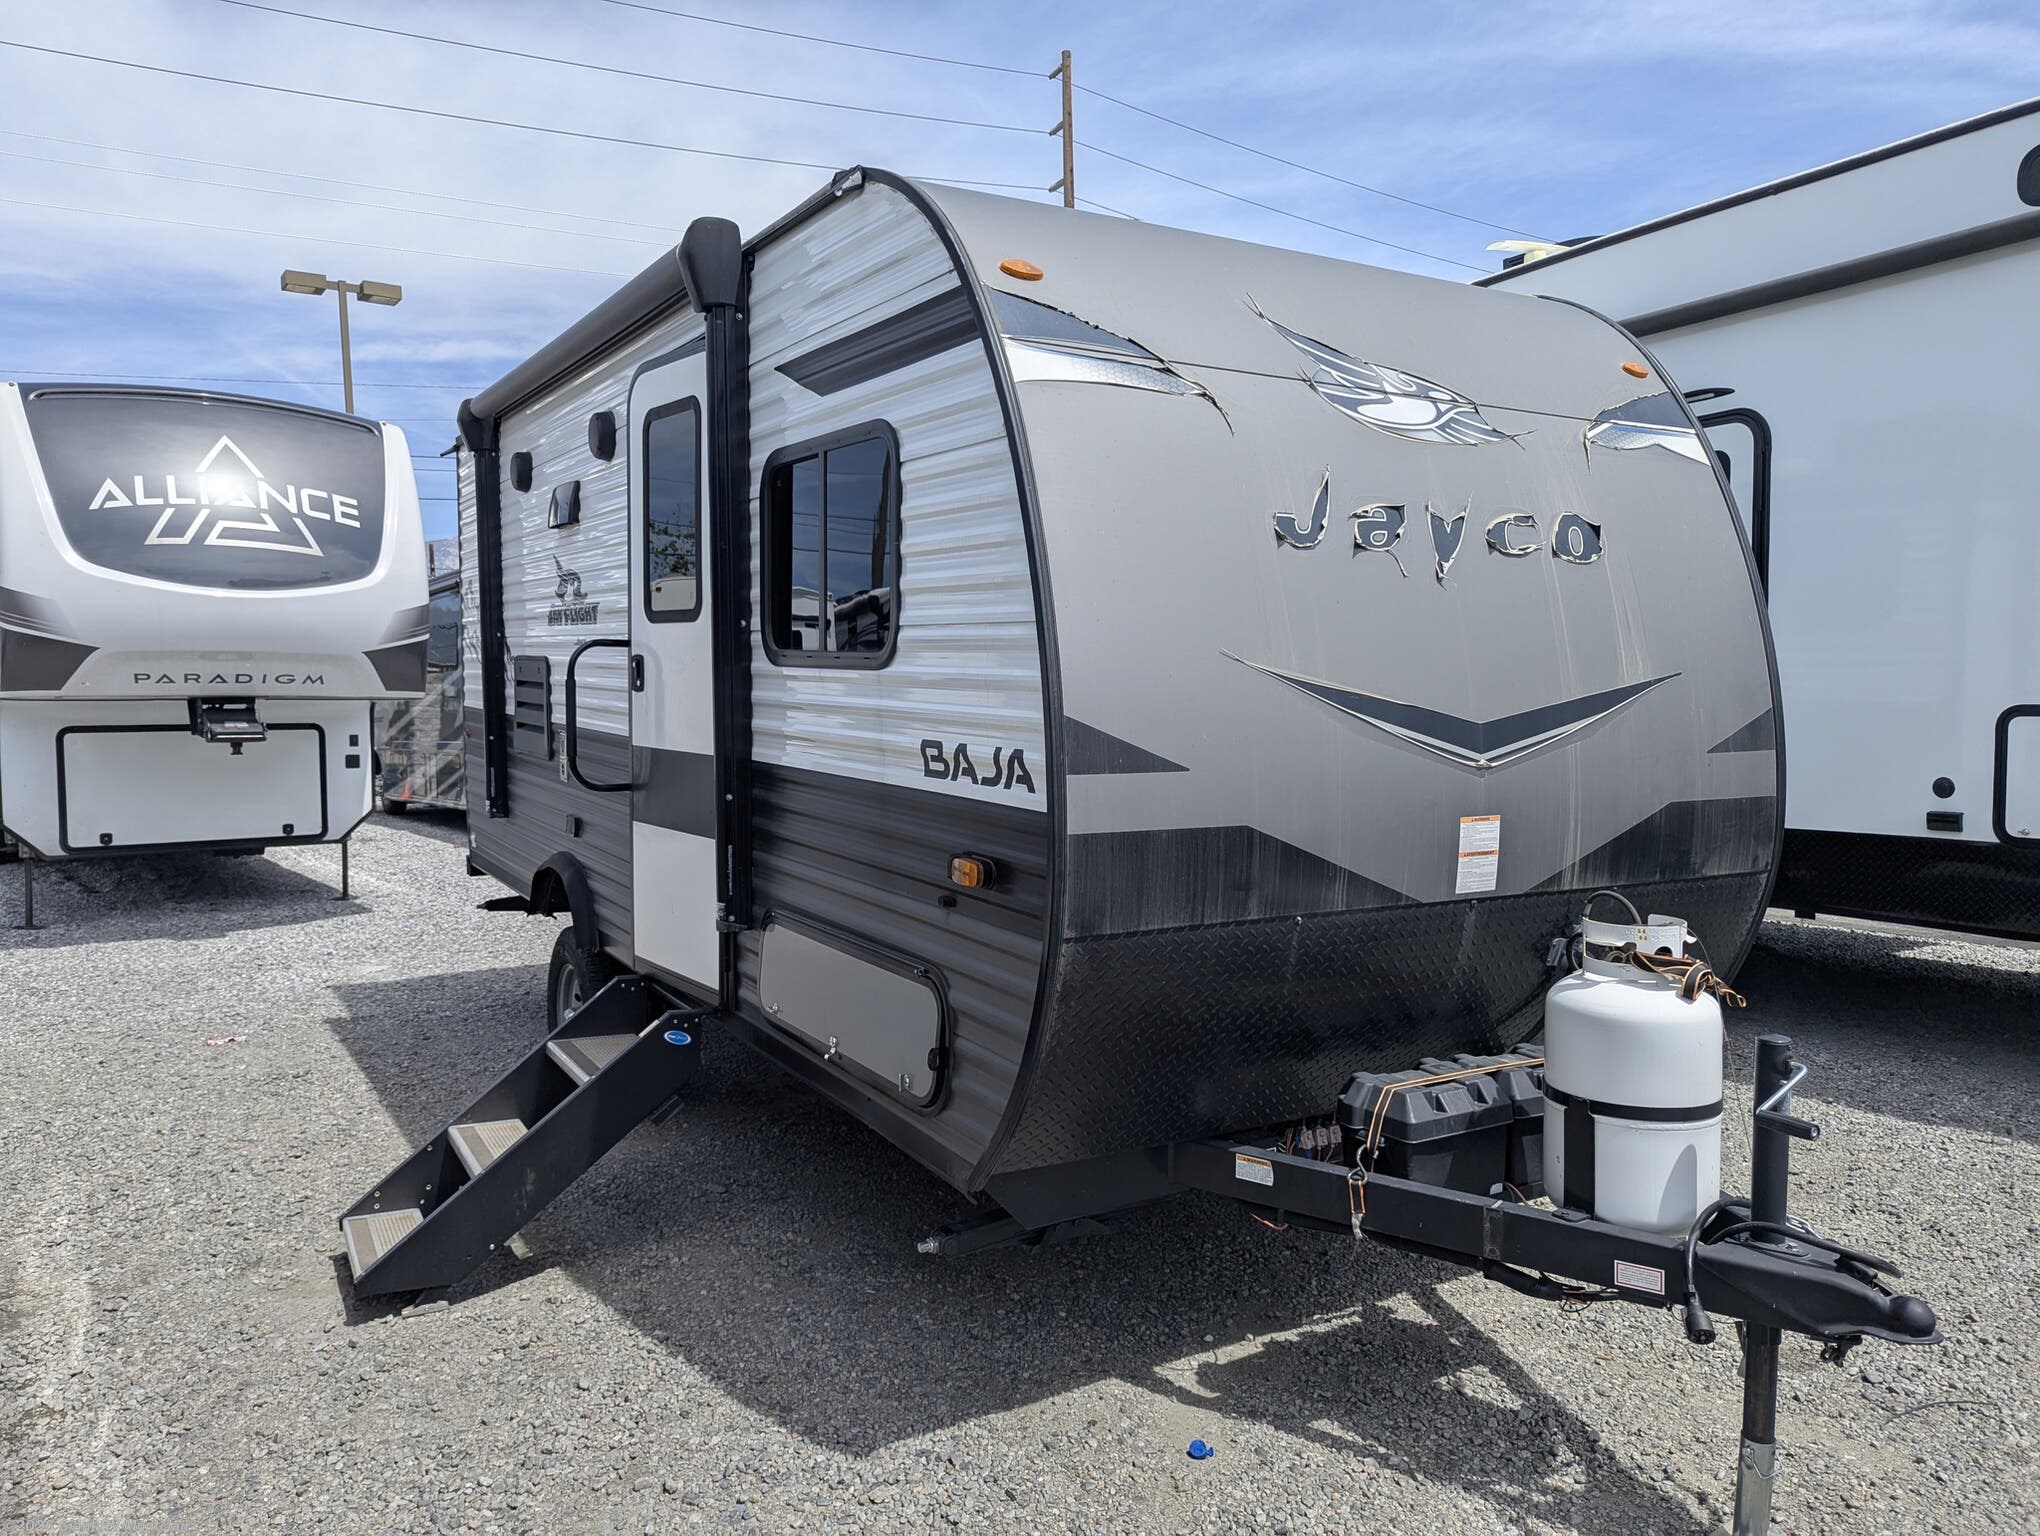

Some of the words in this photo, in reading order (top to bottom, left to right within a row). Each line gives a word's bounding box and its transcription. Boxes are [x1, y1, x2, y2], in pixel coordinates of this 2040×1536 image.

[88, 474, 361, 528] ALLIANCE
[1273, 466, 1602, 586] Jayco
[564, 604, 599, 625] FLIGHT
[133, 673, 325, 685] PARADIGM
[920, 738, 1036, 794] BAJA
